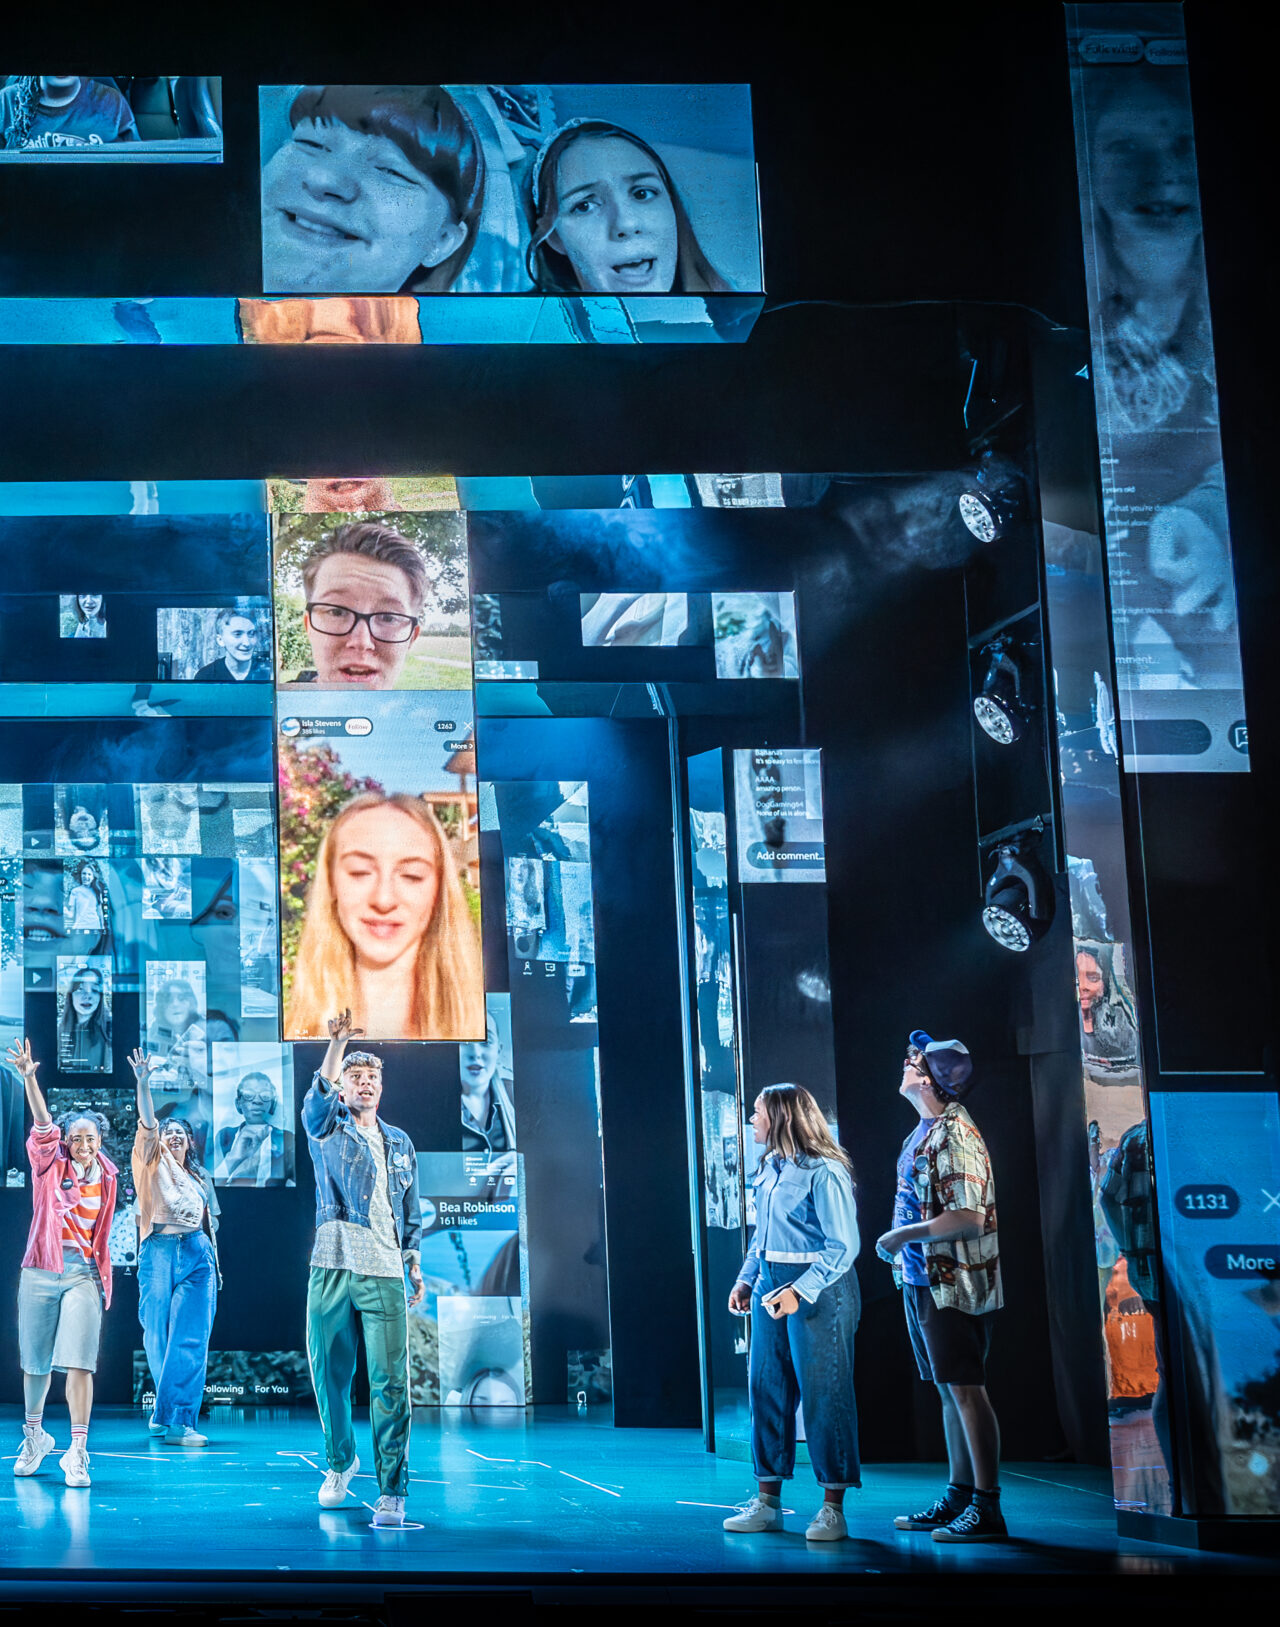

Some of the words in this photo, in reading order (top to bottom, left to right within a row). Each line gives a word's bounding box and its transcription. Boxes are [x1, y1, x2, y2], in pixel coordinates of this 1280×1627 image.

[314, 719, 342, 727] Stevens
[756, 851, 775, 860] Add
[776, 852, 825, 860] comment...
[439, 1202, 461, 1213] Bea
[463, 1201, 516, 1213] Robinson
[1184, 1193, 1230, 1210] 1131
[440, 1217, 455, 1226] 161
[458, 1216, 478, 1226] likes
[1226, 1253, 1276, 1270] More
[202, 1384, 244, 1395] Following
[255, 1385, 269, 1393] For
[271, 1385, 289, 1394] You
